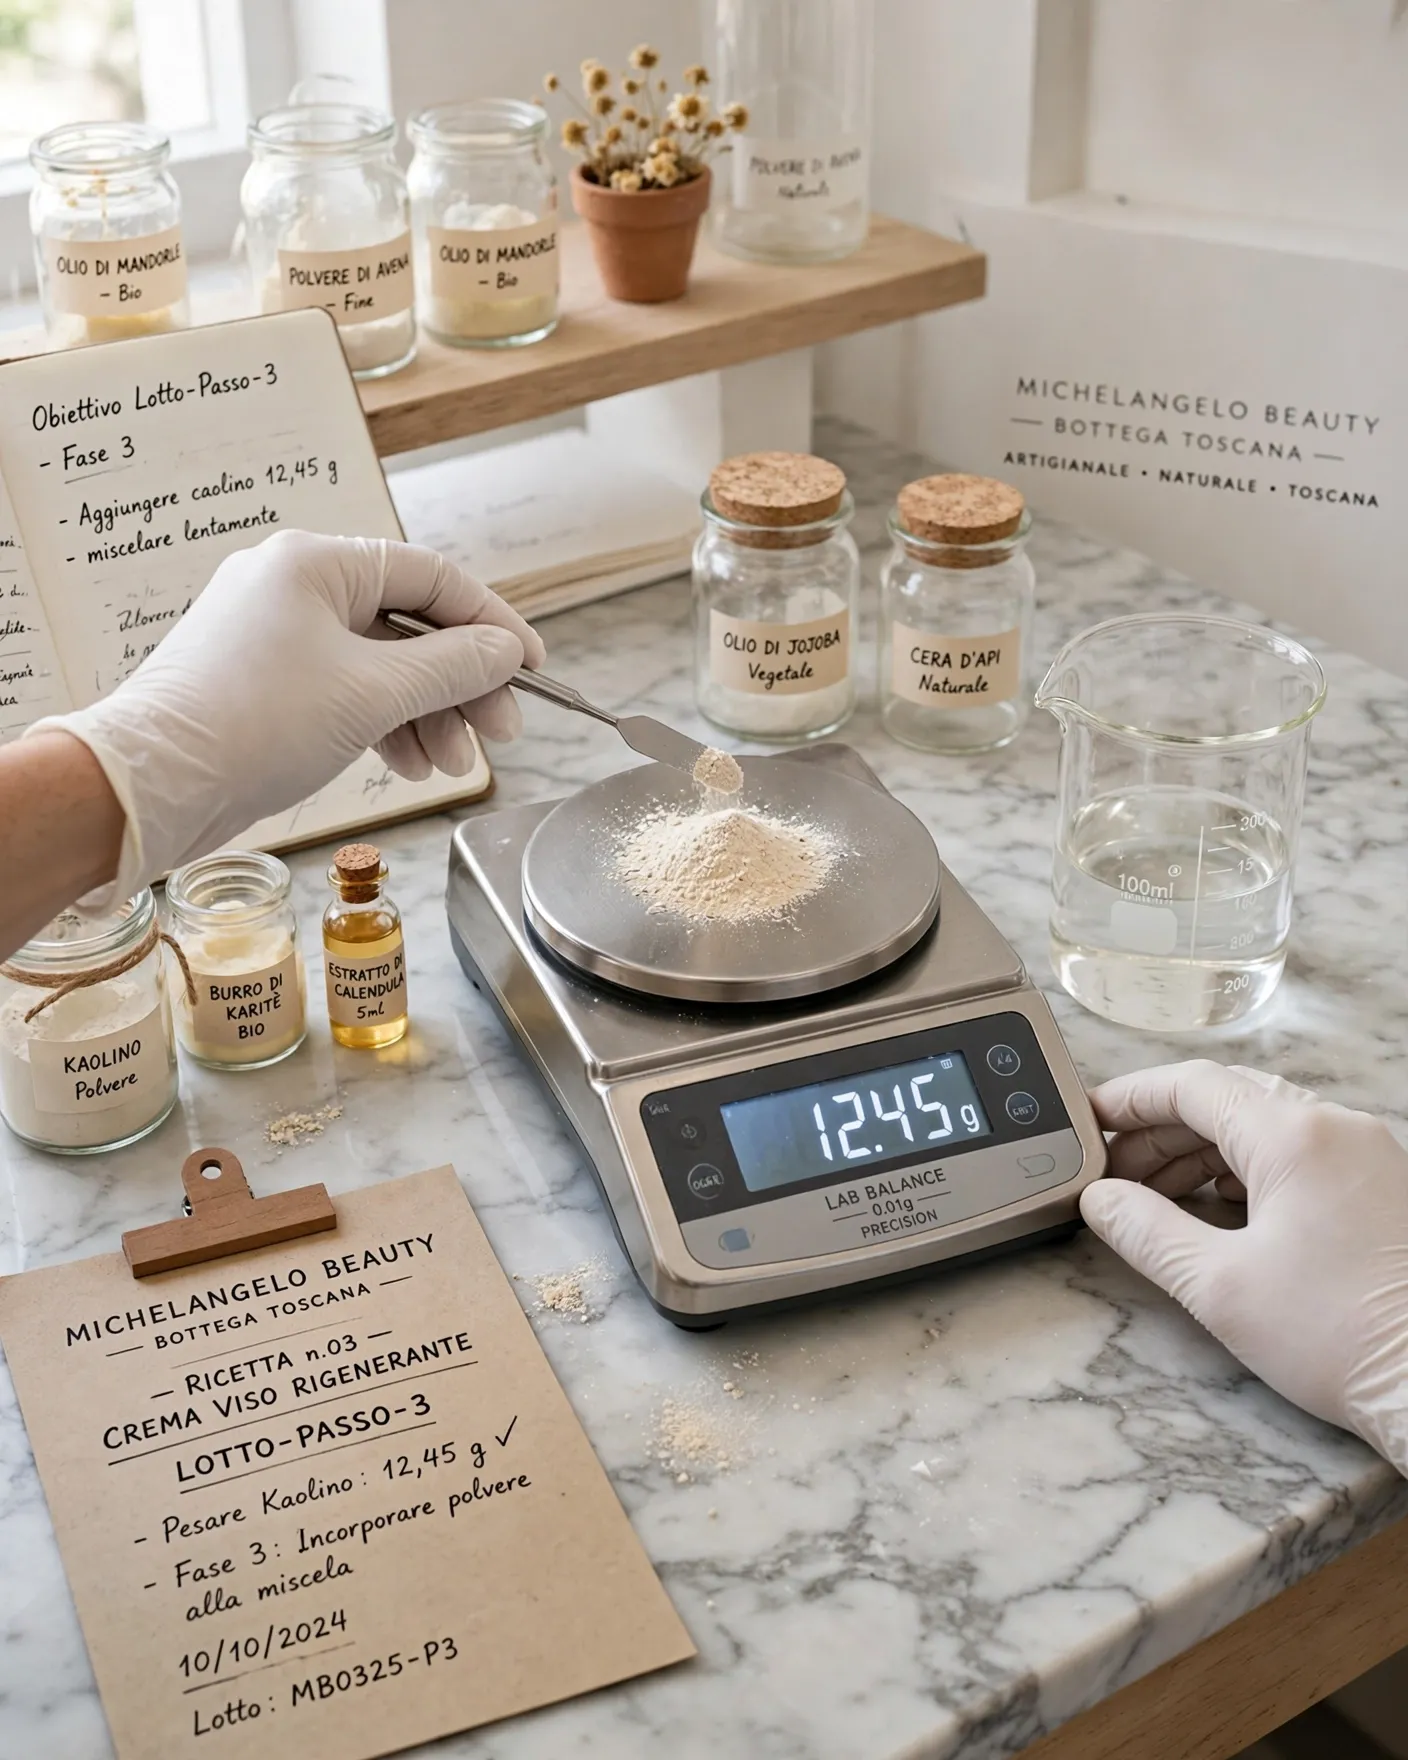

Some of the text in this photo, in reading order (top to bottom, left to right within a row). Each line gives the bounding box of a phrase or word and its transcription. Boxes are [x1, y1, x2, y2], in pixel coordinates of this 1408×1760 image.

[57, 242, 180, 276] OLIO DI MANDORLE
[440, 245, 470, 263] OLIO
[476, 248, 489, 264] DI
[119, 283, 142, 301] Bio
[289, 267, 350, 285] POLVERE
[357, 266, 370, 282] DI
[496, 271, 518, 289] Bio
[344, 292, 374, 312] Fine
[32, 363, 278, 431] Obiettivo Lotto-Passo-3
[1016, 377, 1380, 435] MICHELANGELO BEAUTY
[62, 444, 109, 470] Fase
[121, 436, 135, 458] 3
[1054, 417, 1302, 462] BOTTEGA TOSCANA
[78, 491, 180, 533] Aggiungere
[191, 472, 254, 501] caolino
[265, 457, 319, 486] 12,45
[328, 460, 338, 485] g
[1003, 451, 1379, 508] ARTIGIANALE NATURALE TOSCANA
[87, 531, 173, 564] miscelare
[184, 505, 280, 541] lentamente
[724, 629, 841, 655] OLIO DI JOJOBA
[910, 647, 1000, 669] CERA D'API
[748, 661, 814, 690] Vegetale
[918, 675, 989, 695] Naturale
[1118, 873, 1174, 899] 100ml
[329, 953, 403, 981] ESTRATTO DI
[1223, 974, 1250, 994] 200
[209, 972, 284, 1001] BURRO DI
[335, 972, 405, 999] CALENDULA
[357, 1001, 385, 1019] 5ml
[237, 1022, 265, 1040] BIO
[63, 1039, 142, 1075] KAOLINO
[75, 1072, 138, 1101] Polvere
[812, 1072, 981, 1162] 12.45 g
[825, 1167, 947, 1212] LAB BALANCE
[860, 1209, 938, 1239] PRECISION
[872, 1197, 914, 1217] 0.01g
[65, 1233, 435, 1347] MICHELANGELO BEAUTY
[154, 1282, 371, 1350] BOTTEGA TOSCANA
[184, 1334, 358, 1397] RICETTA n.03
[103, 1332, 473, 1450] CREMA VISO RIGENERANTE
[175, 1393, 431, 1483] LOTTO-PASSO-3
[162, 1509, 246, 1544] Pesare
[382, 1442, 456, 1481] 12,45
[470, 1442, 486, 1469] g
[174, 1558, 236, 1588] Fase
[297, 1500, 435, 1553] Incorporare
[449, 1472, 531, 1517] polvere
[186, 1557, 354, 1622] alla miscela
[179, 1609, 348, 1678] 10/10/2024
[291, 1637, 459, 1707] MB0325-P3
